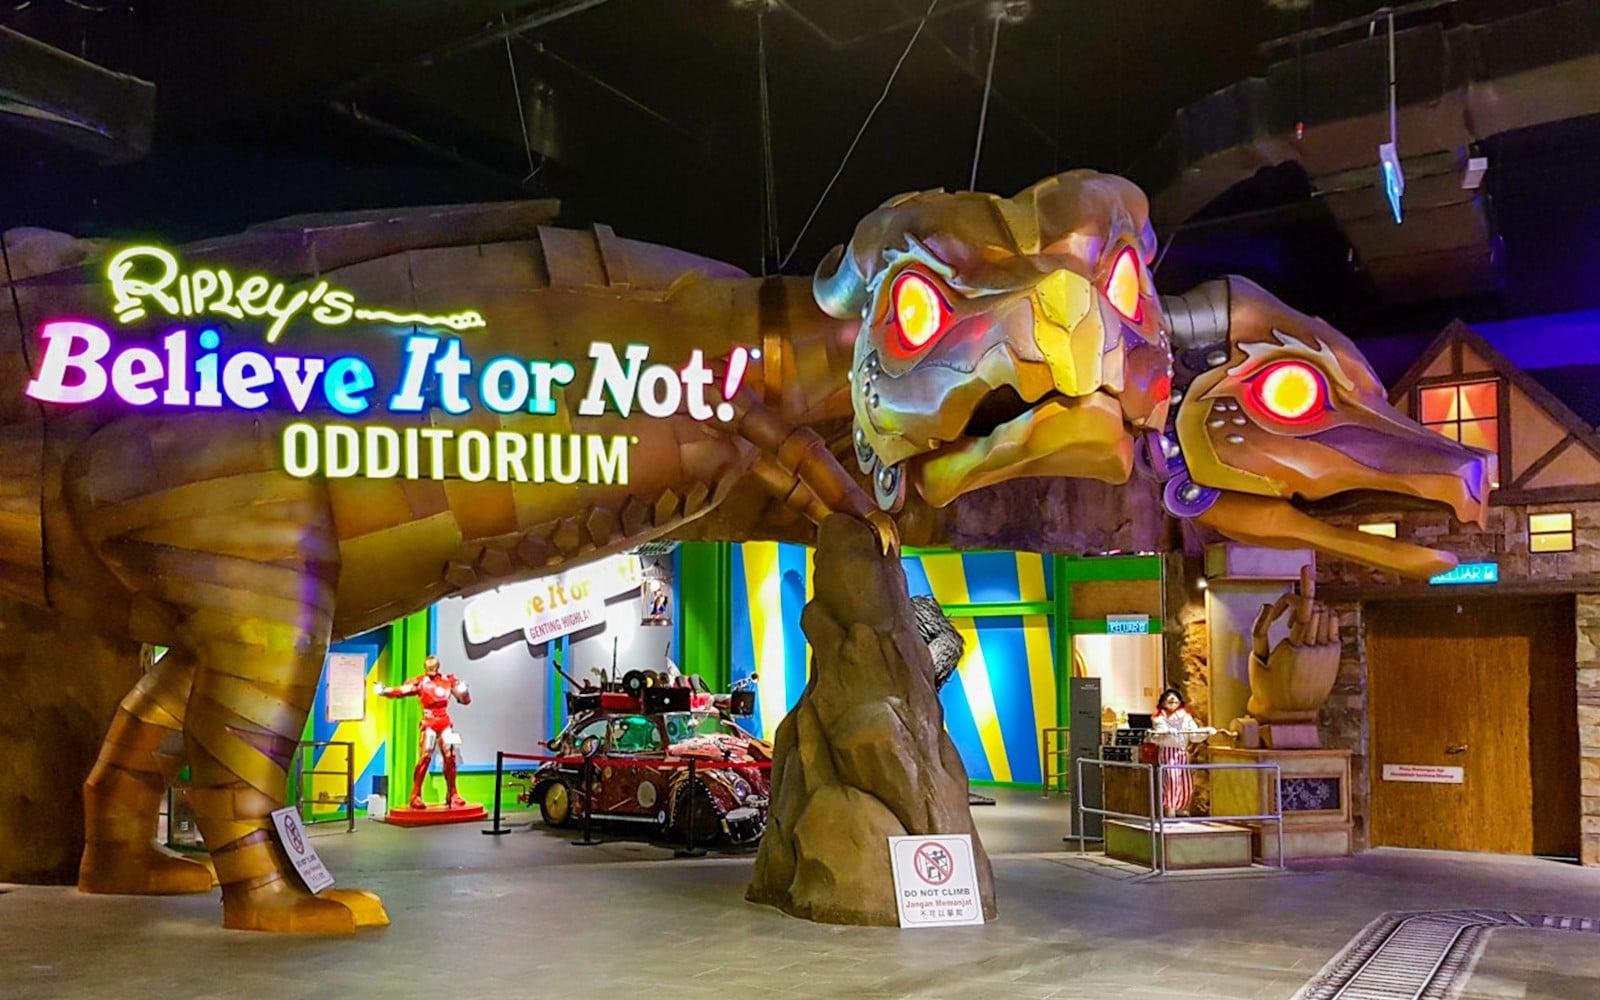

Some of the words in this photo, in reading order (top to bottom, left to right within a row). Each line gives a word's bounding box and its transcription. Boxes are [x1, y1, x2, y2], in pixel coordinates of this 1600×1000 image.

[26, 322, 375, 414] Believe
[388, 336, 472, 415] It
[480, 356, 575, 415] or
[578, 341, 748, 423] Not!
[282, 424, 628, 486] ODDITORIUM
[529, 619, 562, 639] GENTING
[904, 890, 918, 898] DO
[920, 889, 939, 897] NOT
[942, 888, 970, 896] CLIMB
[905, 900, 934, 909] Jangan
